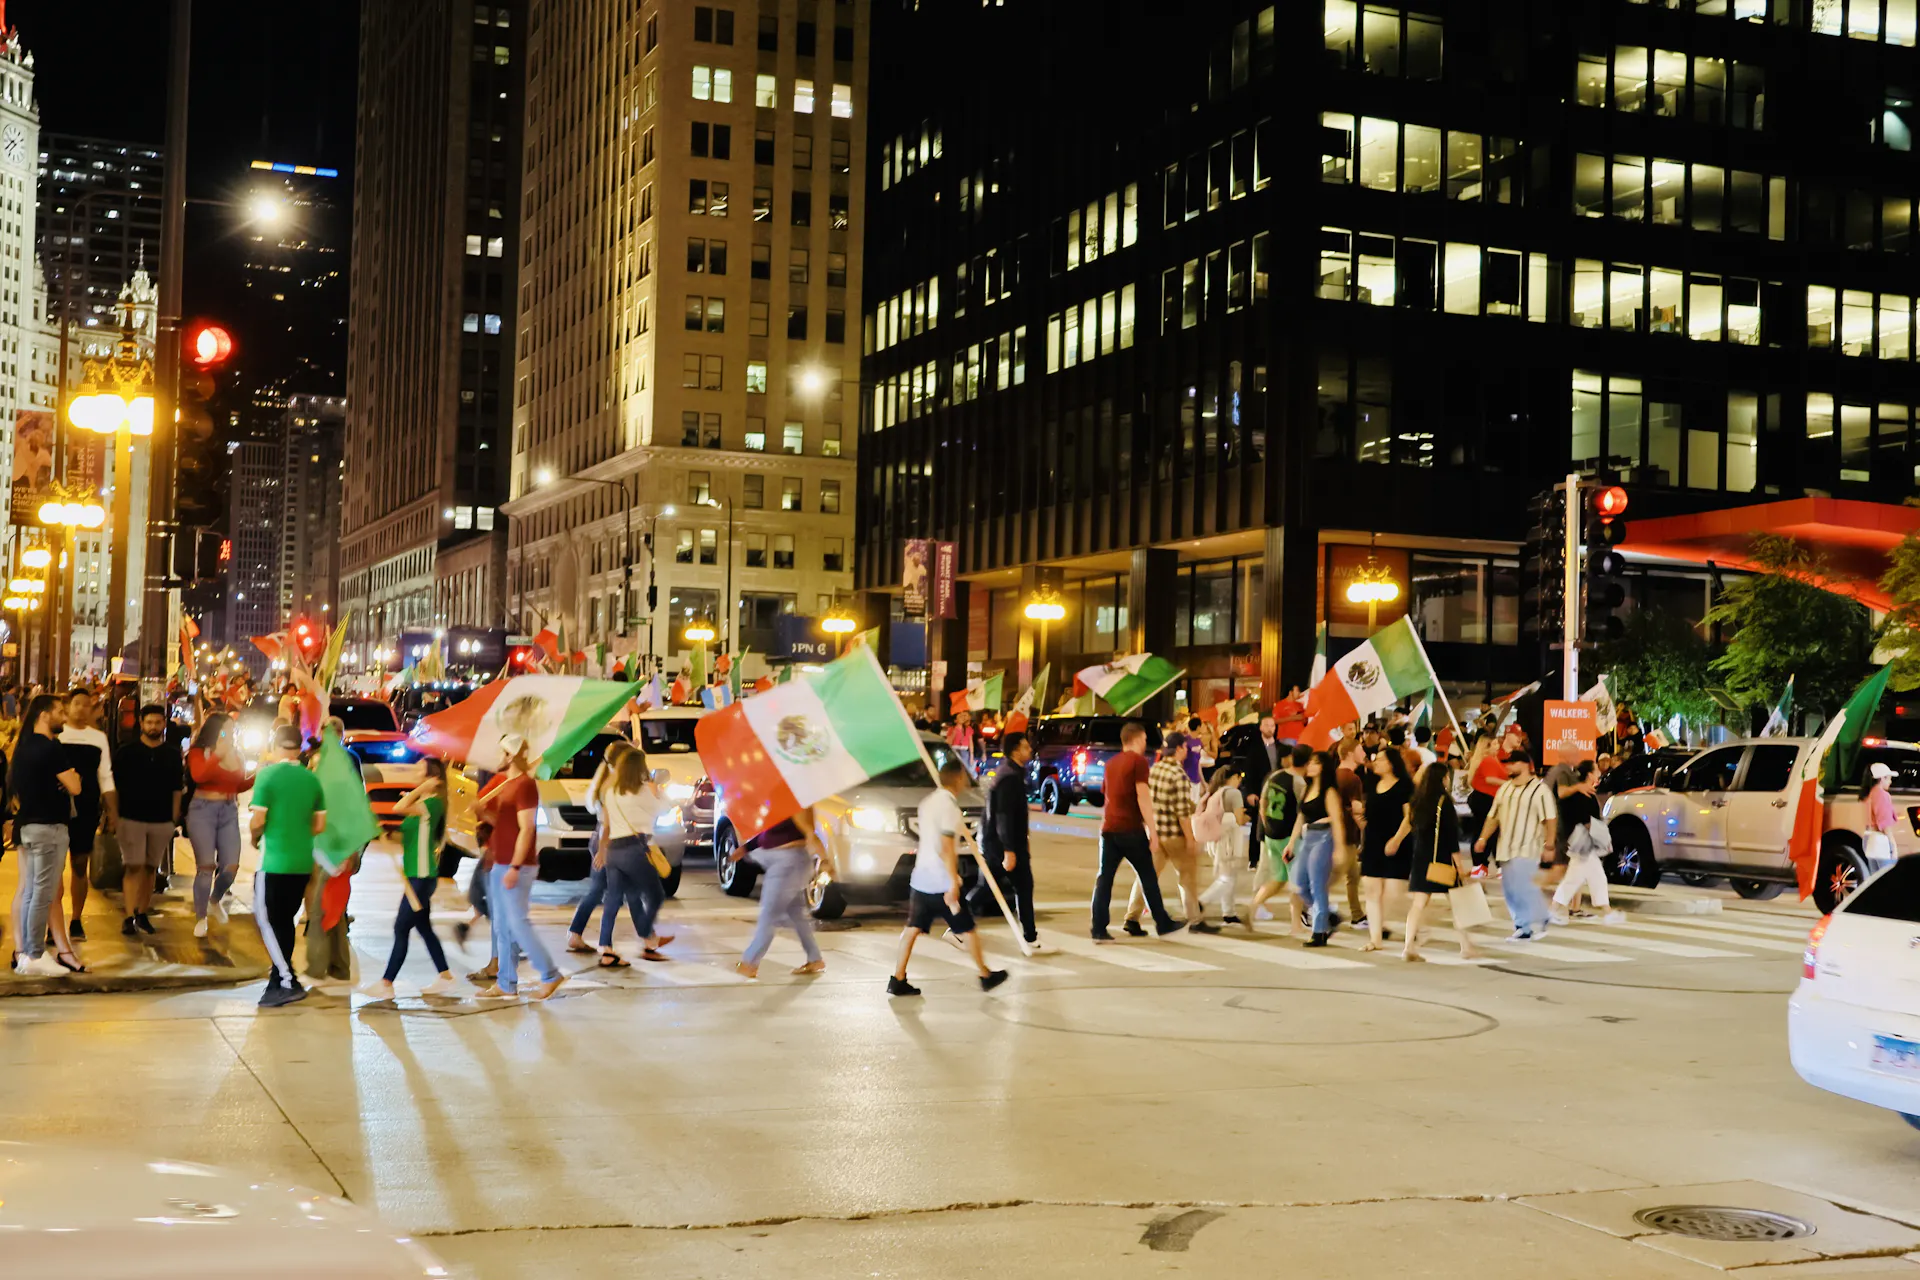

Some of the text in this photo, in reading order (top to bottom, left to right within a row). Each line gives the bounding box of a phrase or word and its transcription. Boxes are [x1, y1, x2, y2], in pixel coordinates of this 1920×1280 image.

[1550, 708, 1591, 719] WALKERS:
[1562, 728, 1578, 740] USE
[1545, 738, 1594, 751] CROWALK
